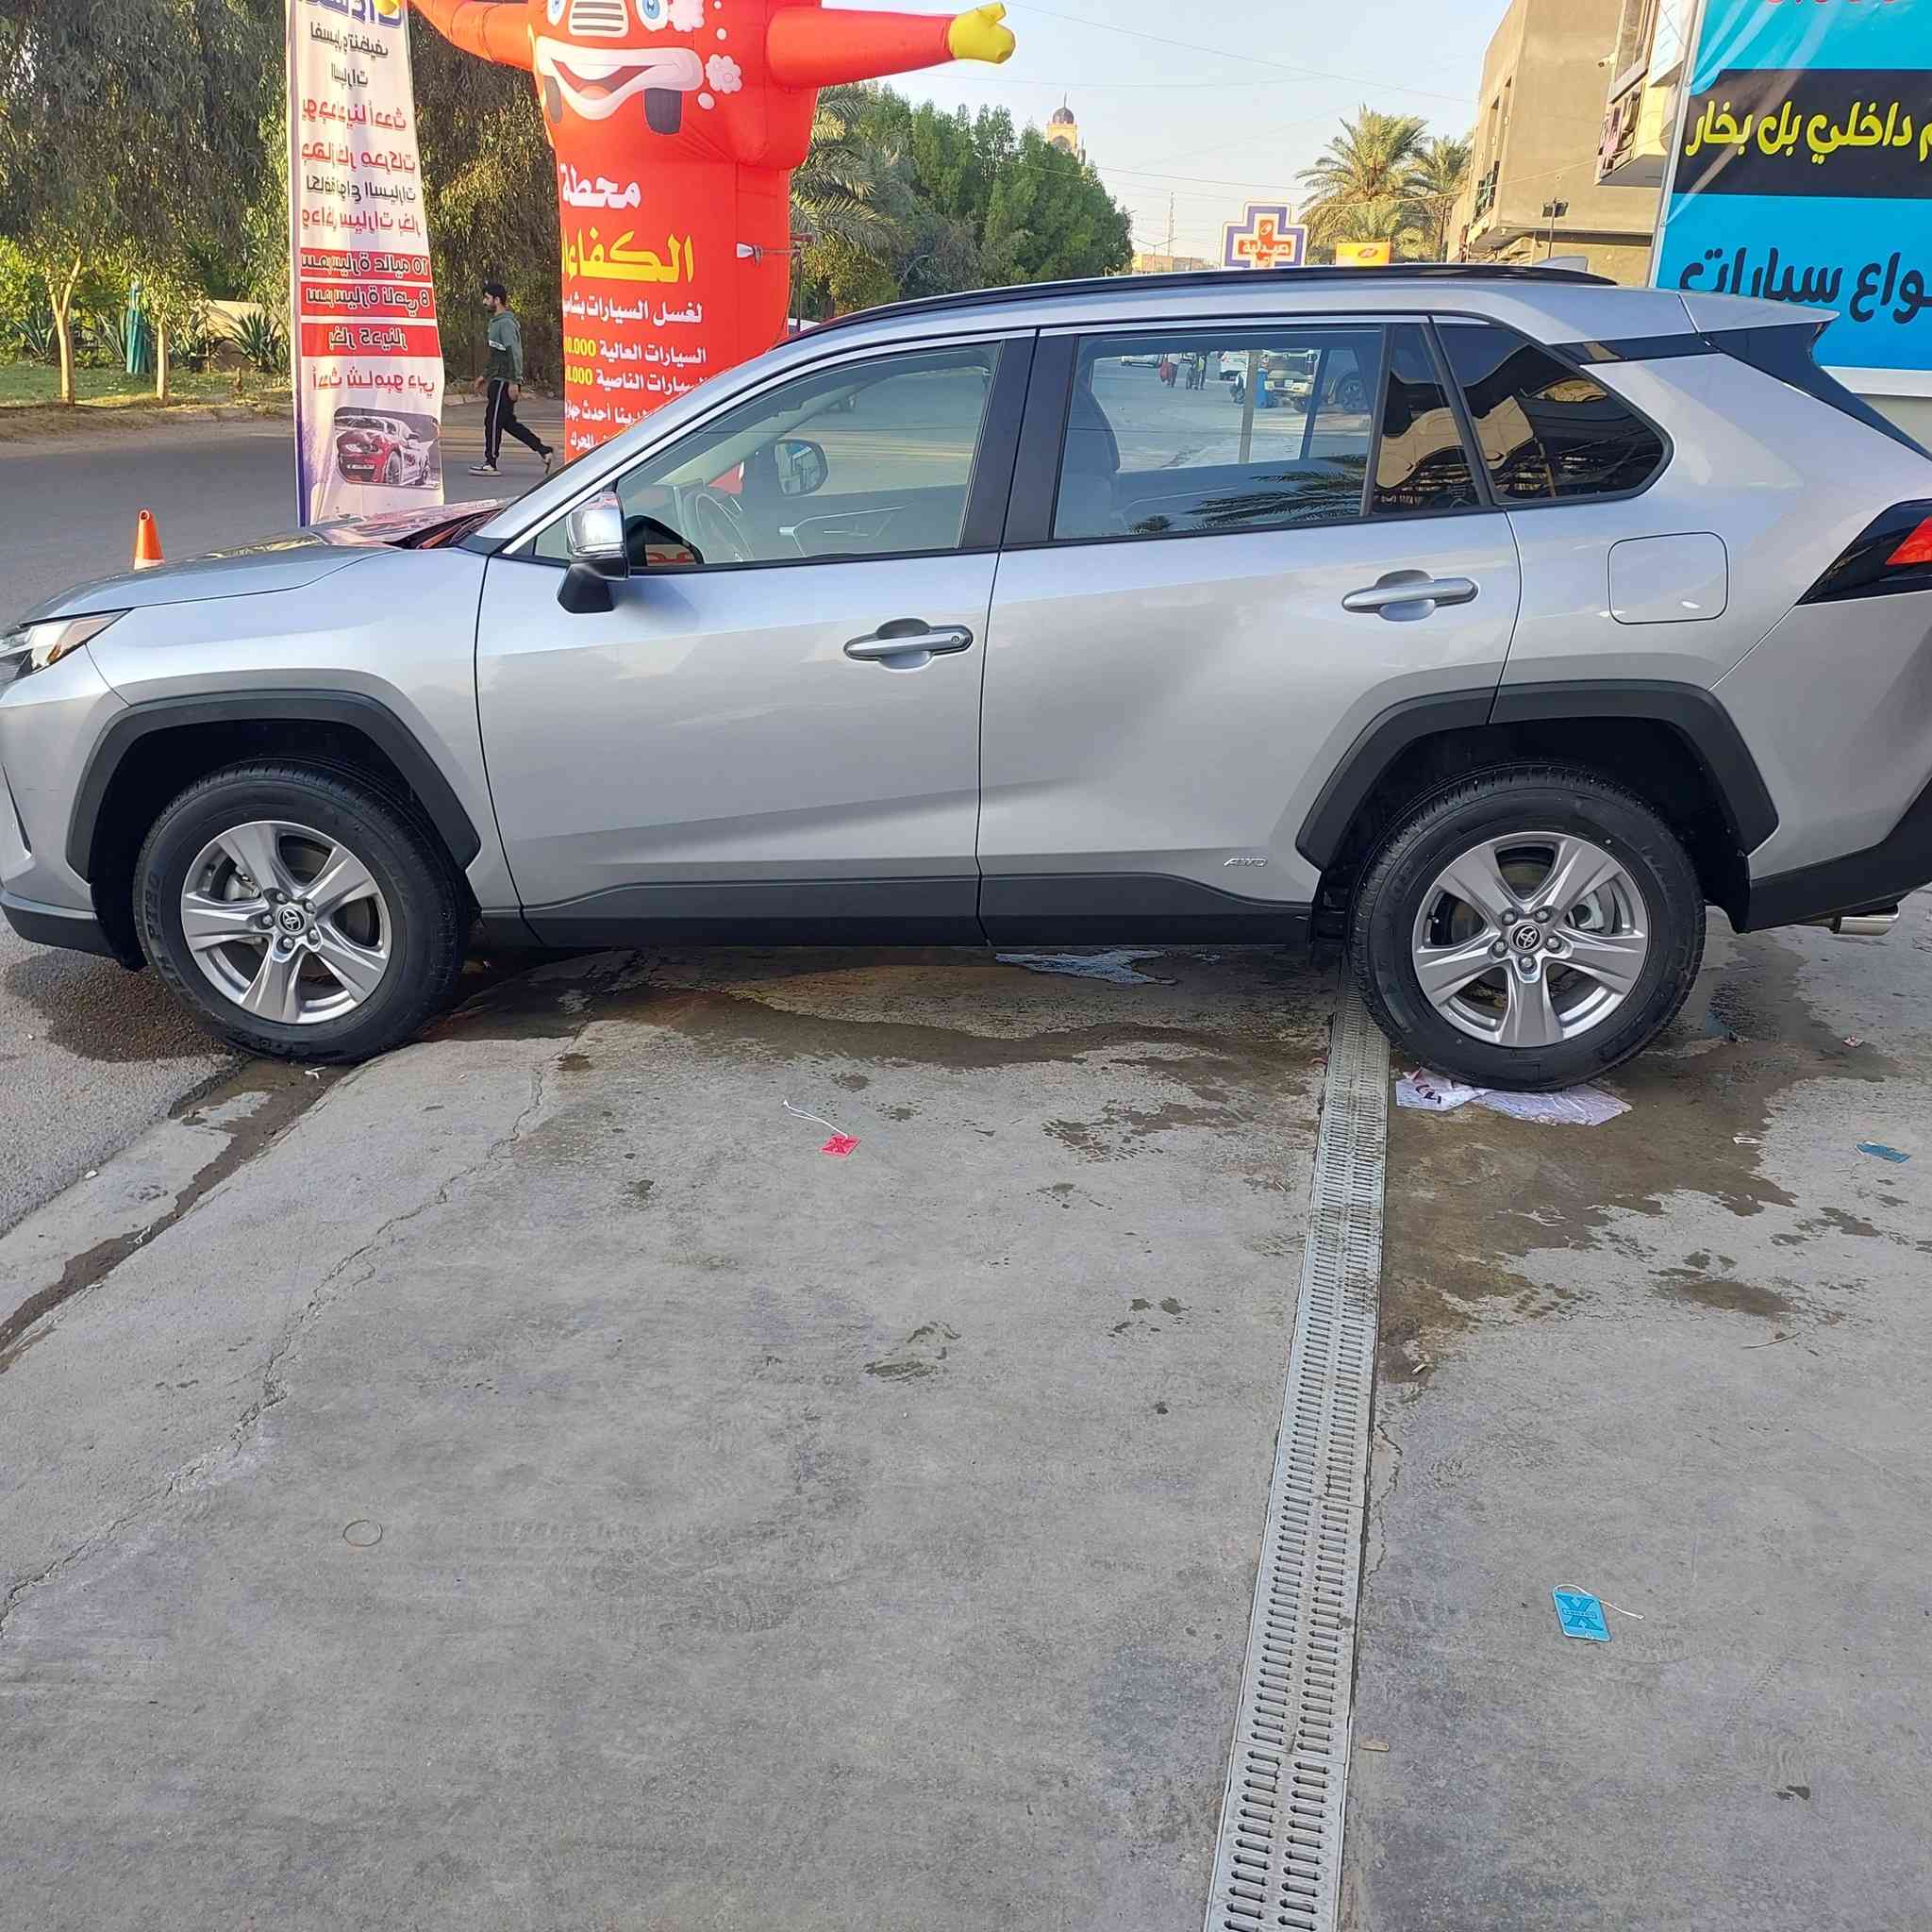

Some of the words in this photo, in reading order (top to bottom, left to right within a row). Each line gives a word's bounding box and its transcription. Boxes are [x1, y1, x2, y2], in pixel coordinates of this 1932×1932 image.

[1685, 100, 1753, 156] بخار
[1757, 101, 1802, 156] بل
[1806, 101, 1912, 164] داخلي
[559, 161, 641, 209] محطة
[586, 294, 649, 324] السيارات
[652, 301, 703, 326] لغسل
[598, 339, 642, 363] العالية
[644, 342, 707, 367] السيارات
[595, 367, 645, 392] الناصية
